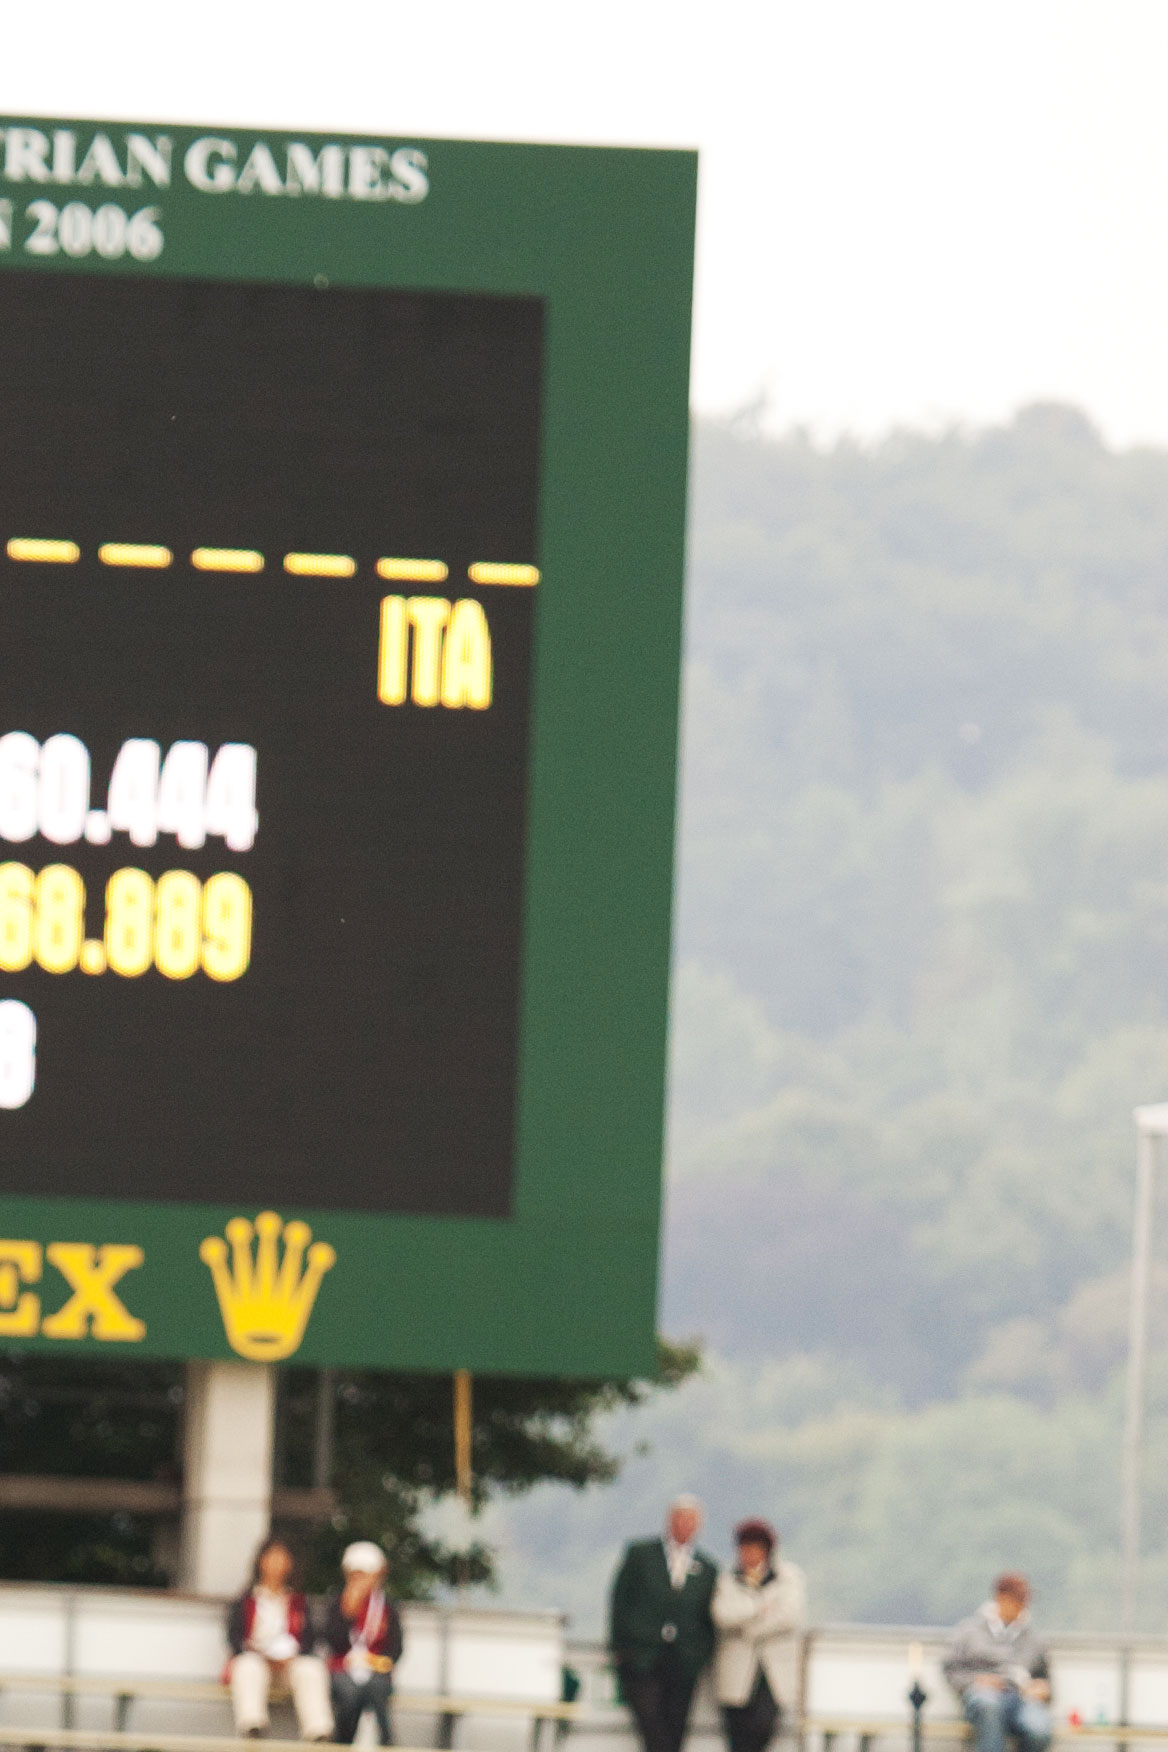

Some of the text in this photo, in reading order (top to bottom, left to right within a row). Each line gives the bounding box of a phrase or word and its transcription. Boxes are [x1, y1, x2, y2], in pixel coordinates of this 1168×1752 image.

[184, 137, 430, 203] GAMES
[24, 199, 165, 261] 2006
[376, 594, 493, 711] ITA
